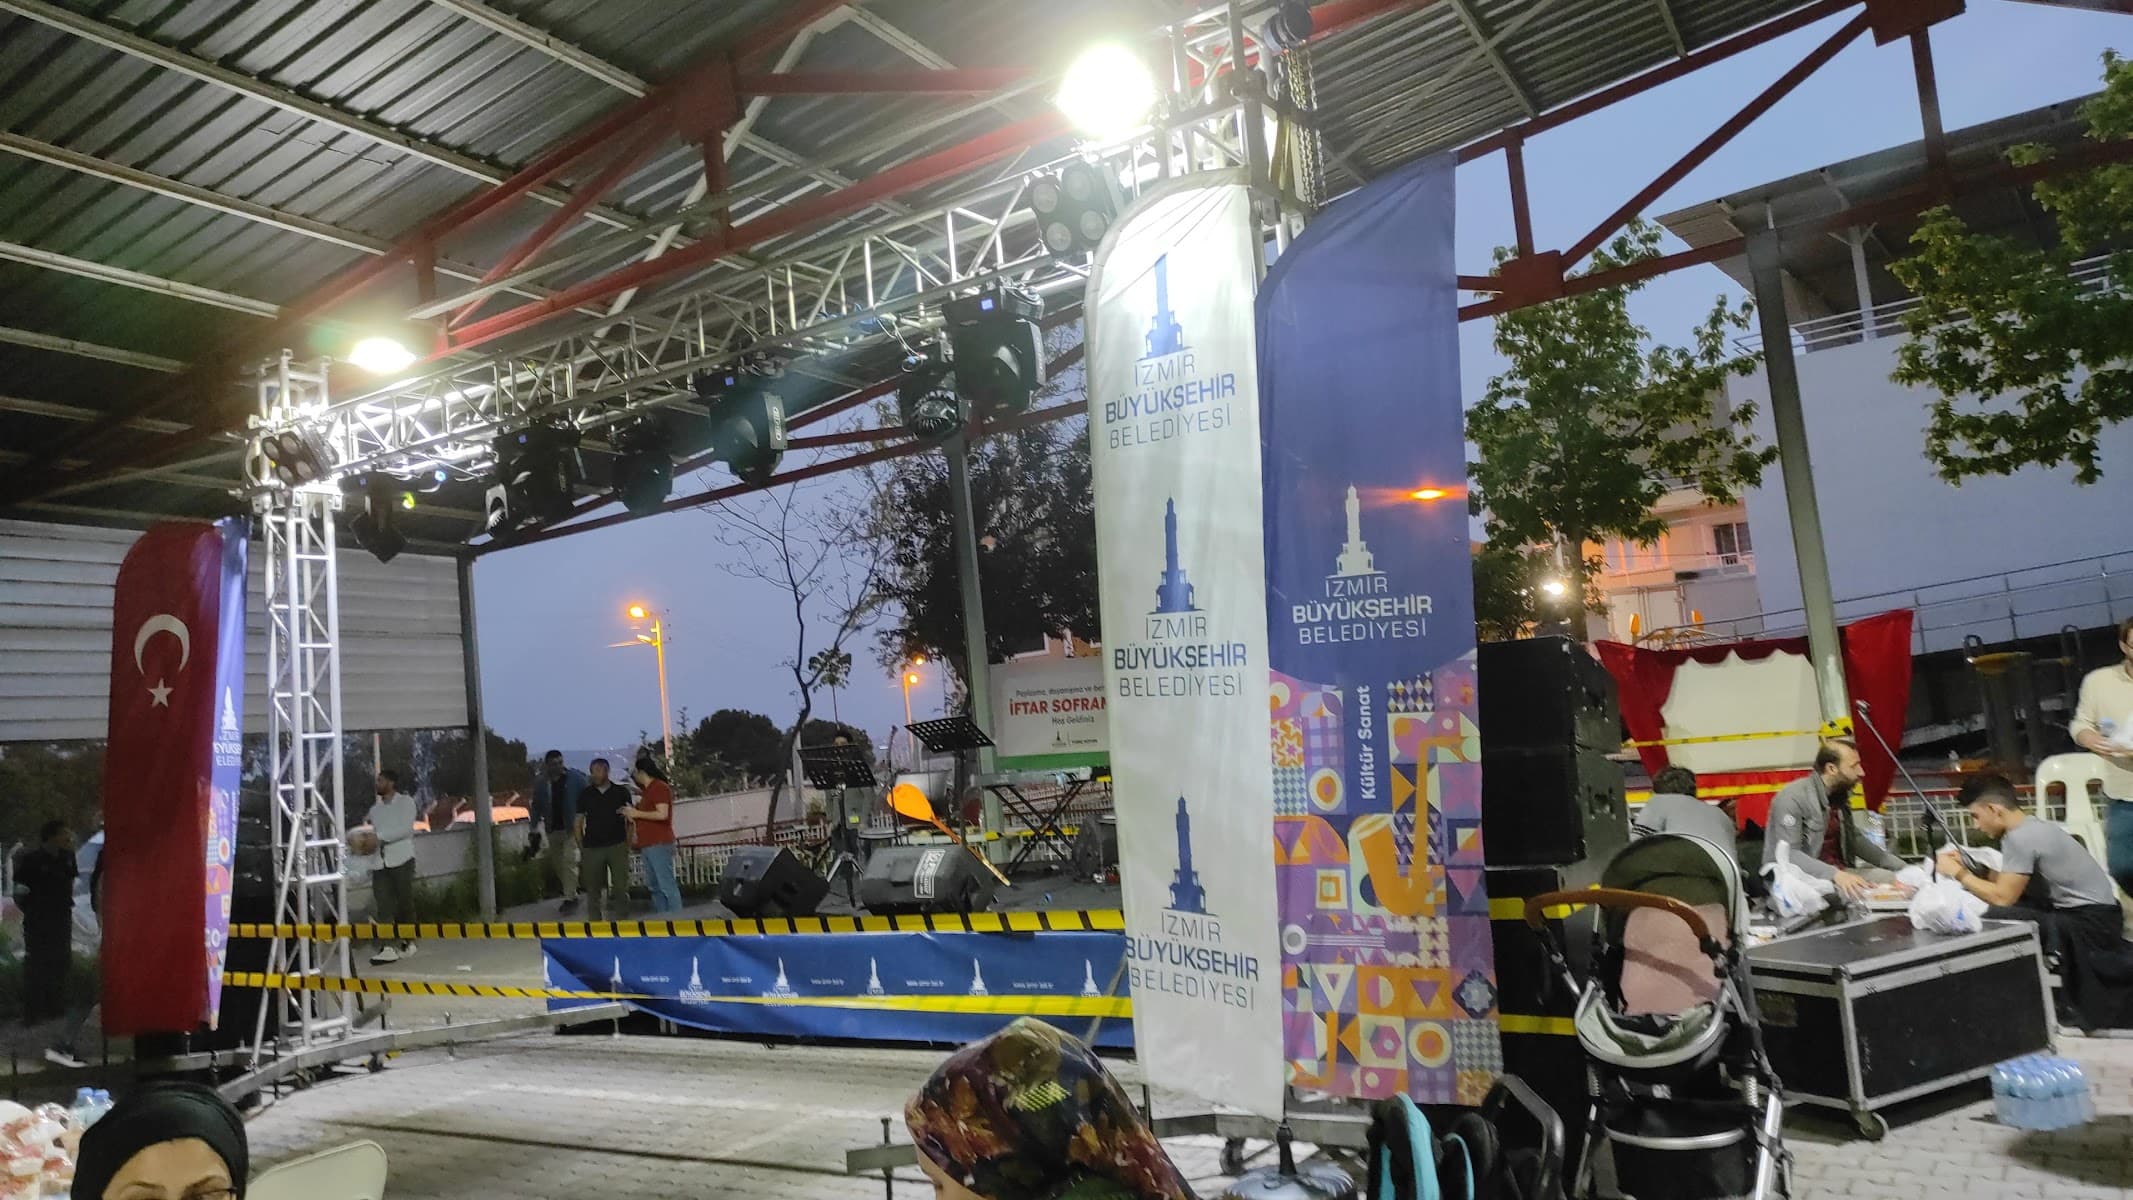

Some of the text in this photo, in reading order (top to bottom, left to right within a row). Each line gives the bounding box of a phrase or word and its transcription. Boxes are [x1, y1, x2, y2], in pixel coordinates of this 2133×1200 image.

[1105, 372, 1235, 424] BÜYÜKŞEHİR
[1109, 402, 1231, 449] BELEDİYESİ
[1292, 593, 1433, 624] BÜYÜKŞEHİR
[1300, 617, 1427, 645] BELEDİYESİ
[1114, 640, 1247, 671] BÜYÜKŞEHİR
[1119, 672, 1242, 697] BELEDİYESİ
[1009, 698, 1049, 716] İFTAR
[1357, 684, 1376, 800] Kültür Sanat
[1126, 933, 1259, 982] BÜYÜKŞEHİR
[1131, 967, 1255, 1011] BELEDİYESİ
